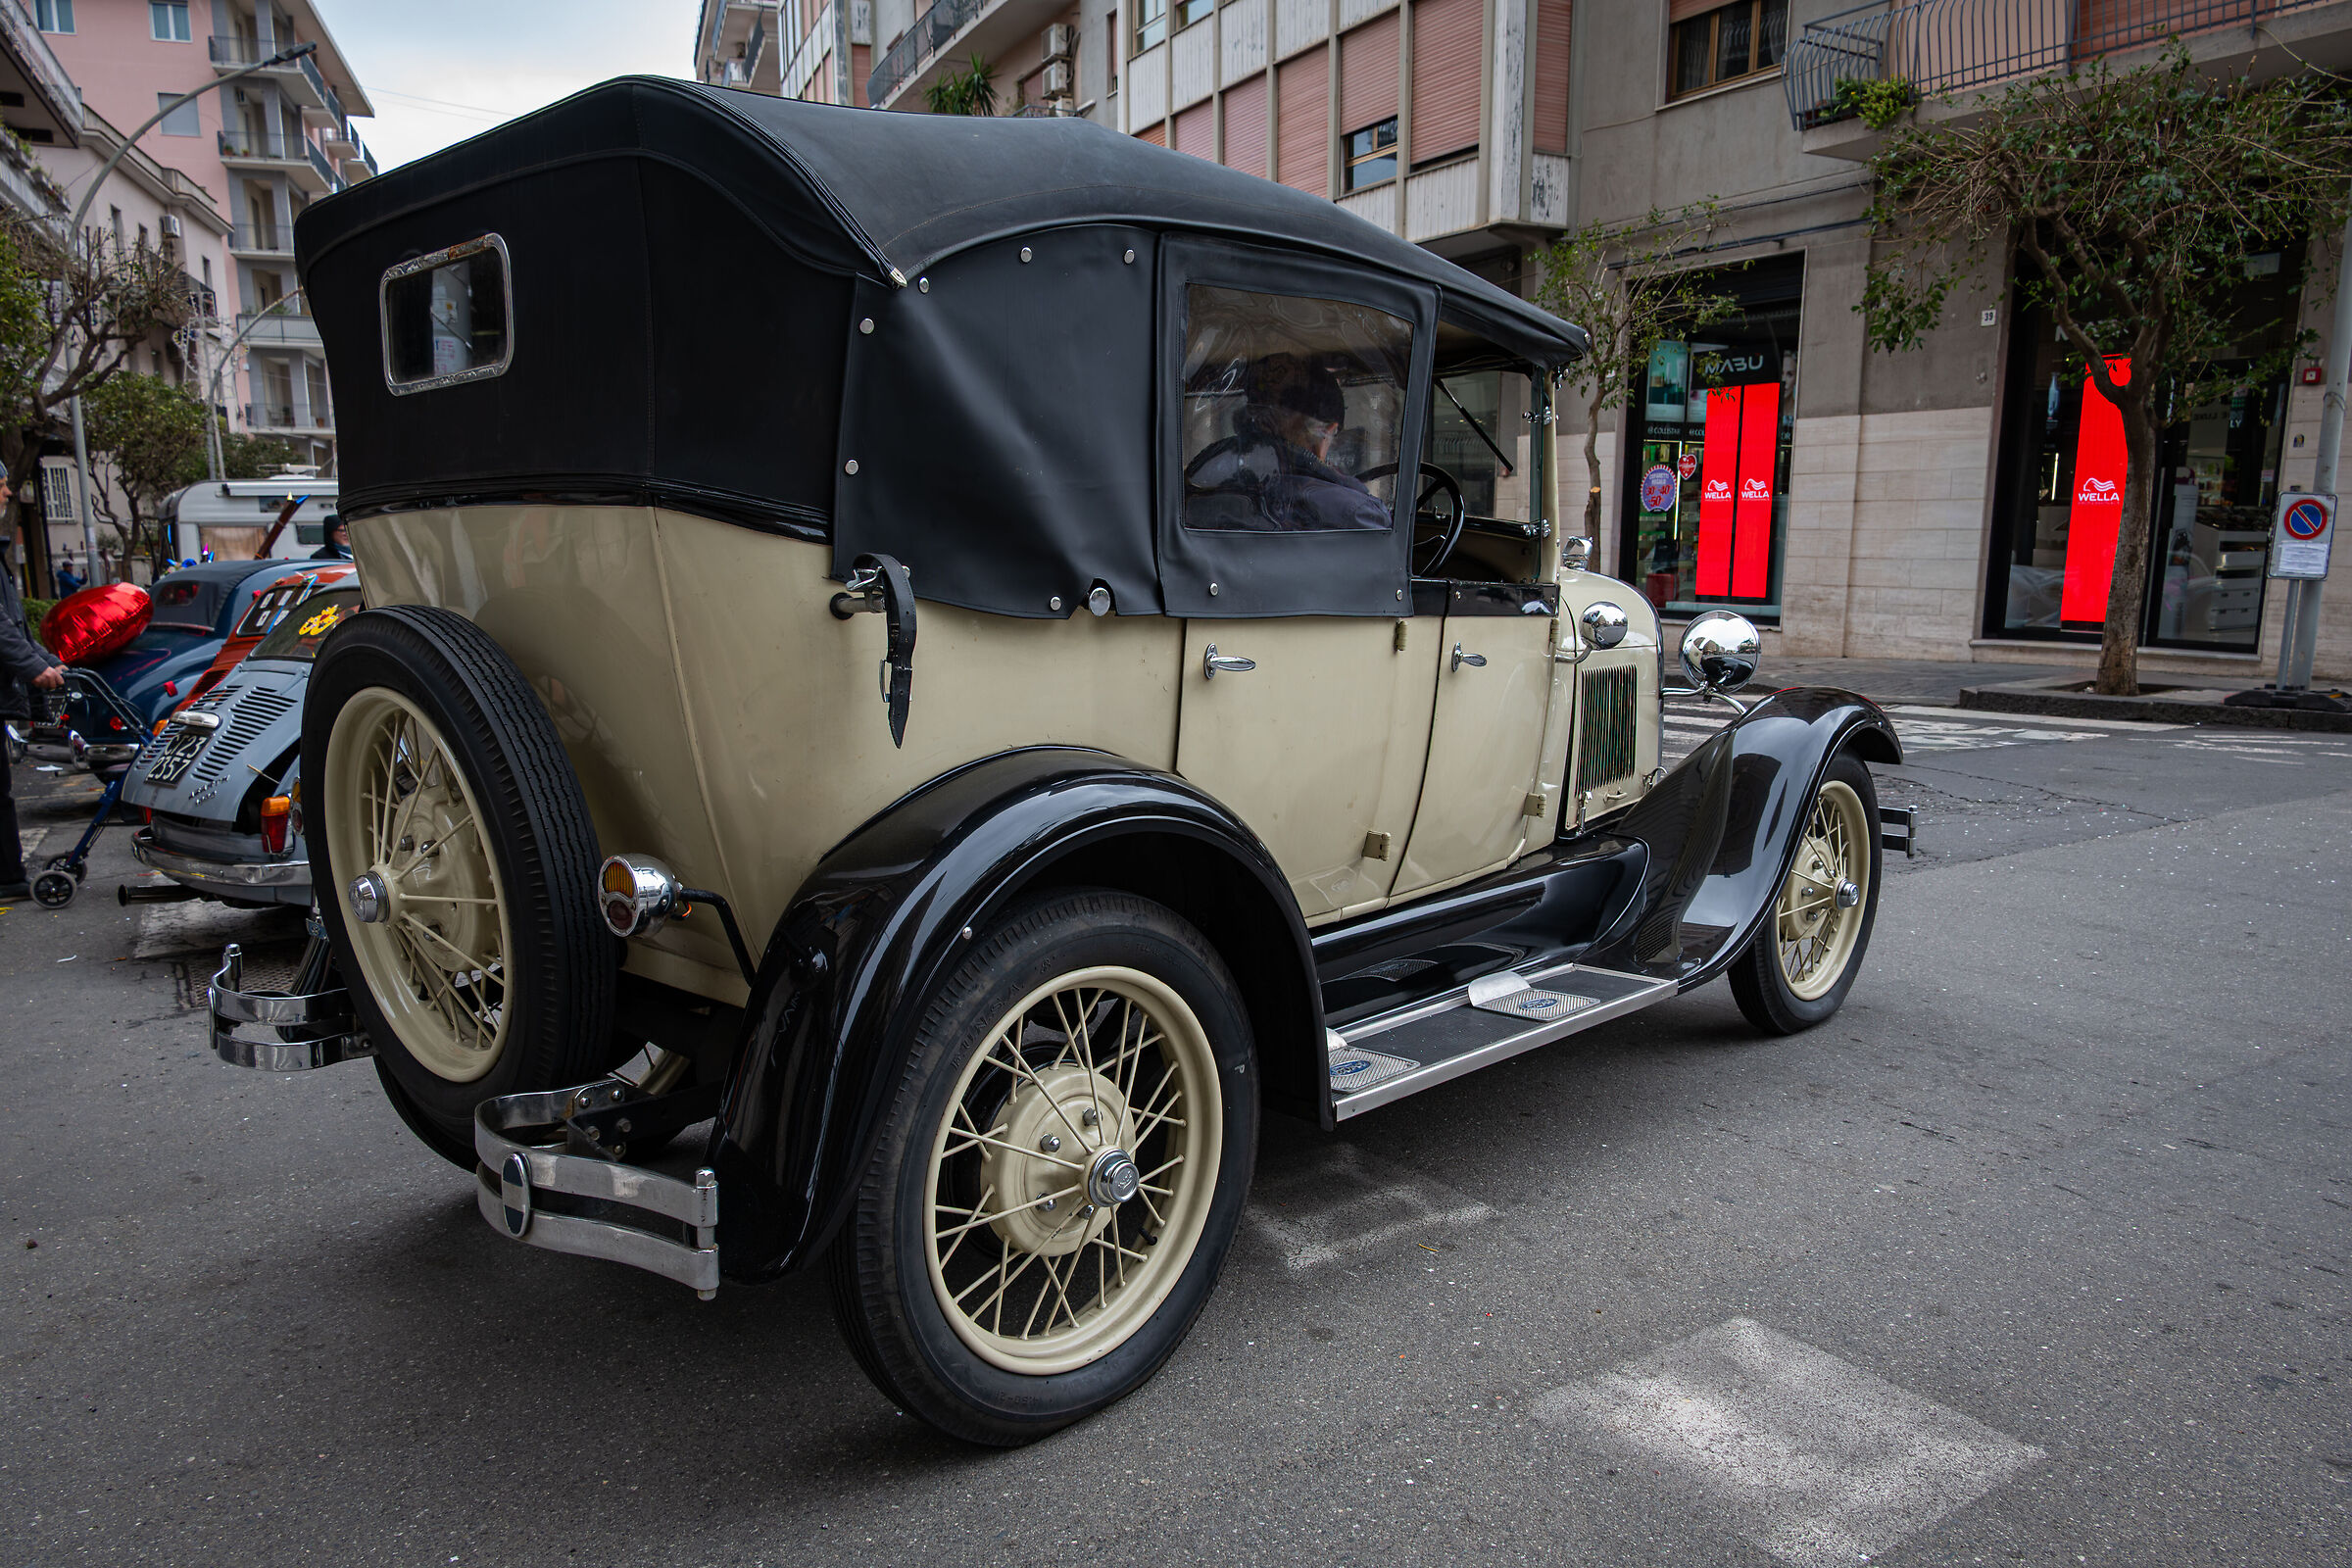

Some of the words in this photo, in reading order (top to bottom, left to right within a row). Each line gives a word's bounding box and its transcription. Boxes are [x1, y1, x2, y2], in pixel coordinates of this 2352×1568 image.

[1984, 312, 1994, 321] 39
[1740, 490, 1770, 499] WELLA
[2078, 492, 2120, 501] WELLA
[148, 756, 191, 781] 2357
